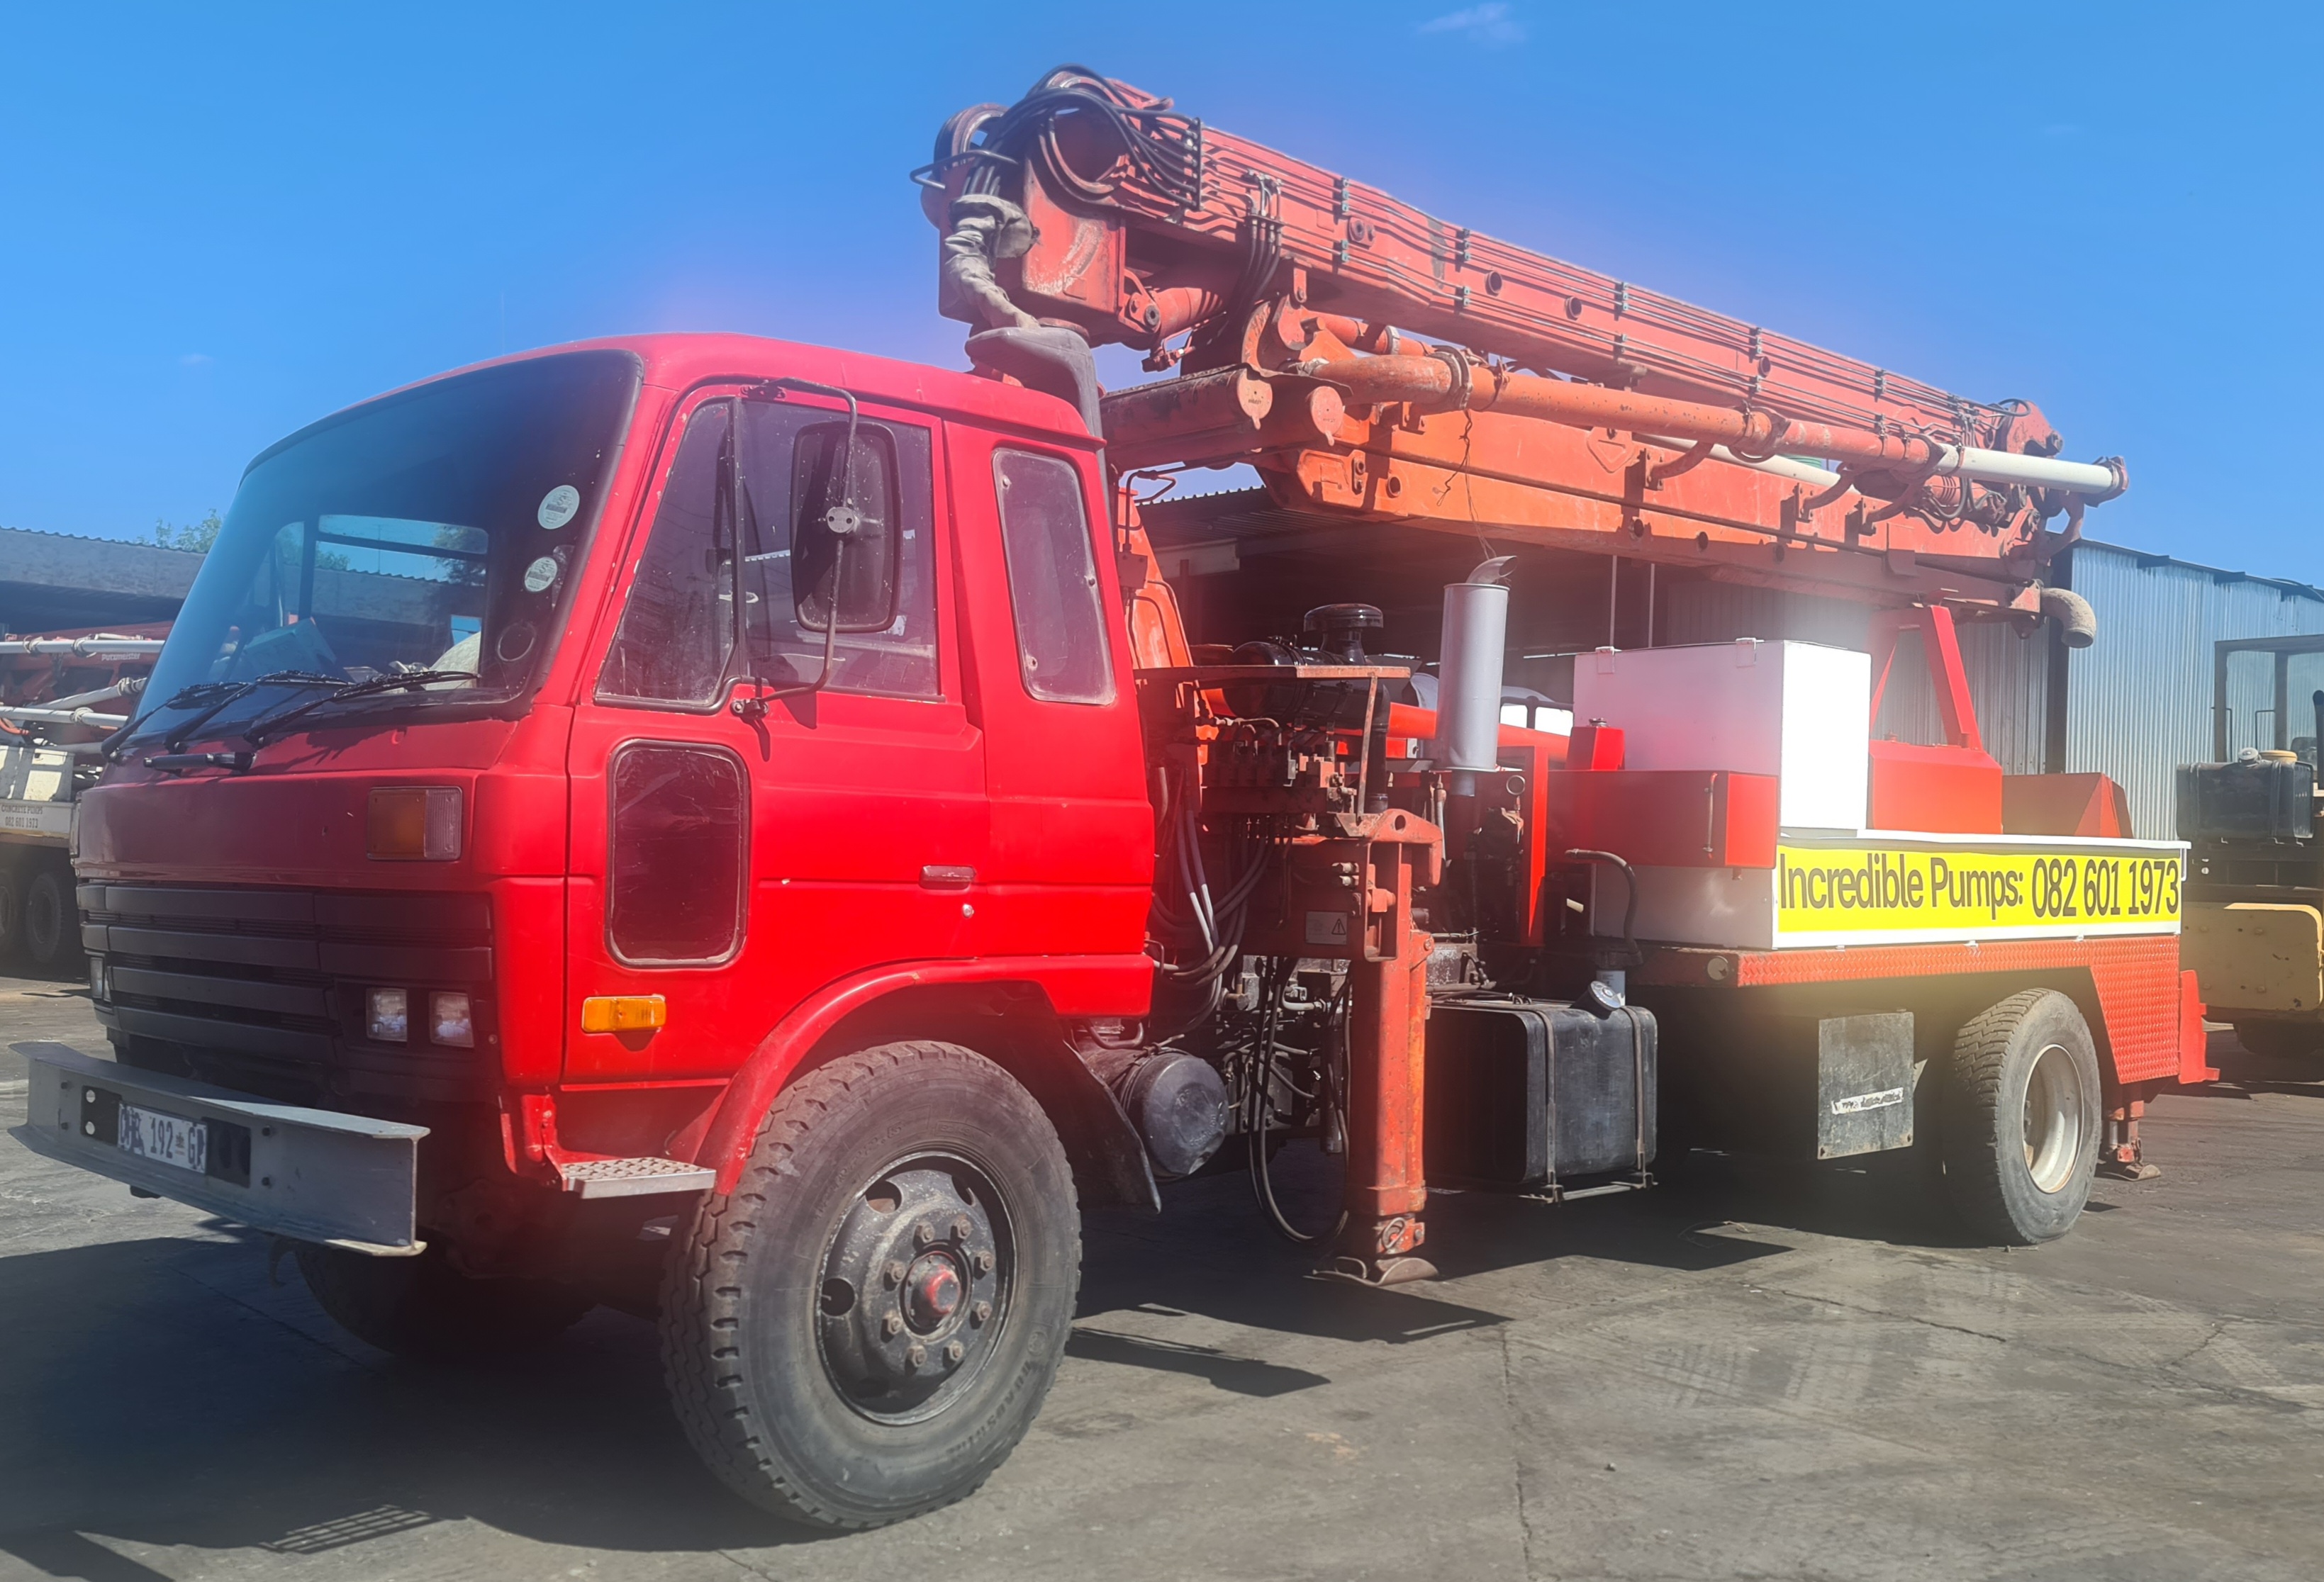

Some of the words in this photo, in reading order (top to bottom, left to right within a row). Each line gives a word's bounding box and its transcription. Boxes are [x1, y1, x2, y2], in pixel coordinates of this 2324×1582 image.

[1780, 853, 1923, 909] Incredible
[1930, 857, 2023, 920] Pumps:
[2032, 858, 2077, 918] 082
[2084, 859, 2121, 916] 601
[2128, 860, 2179, 915] 1973
[150, 1117, 173, 1159] 192
